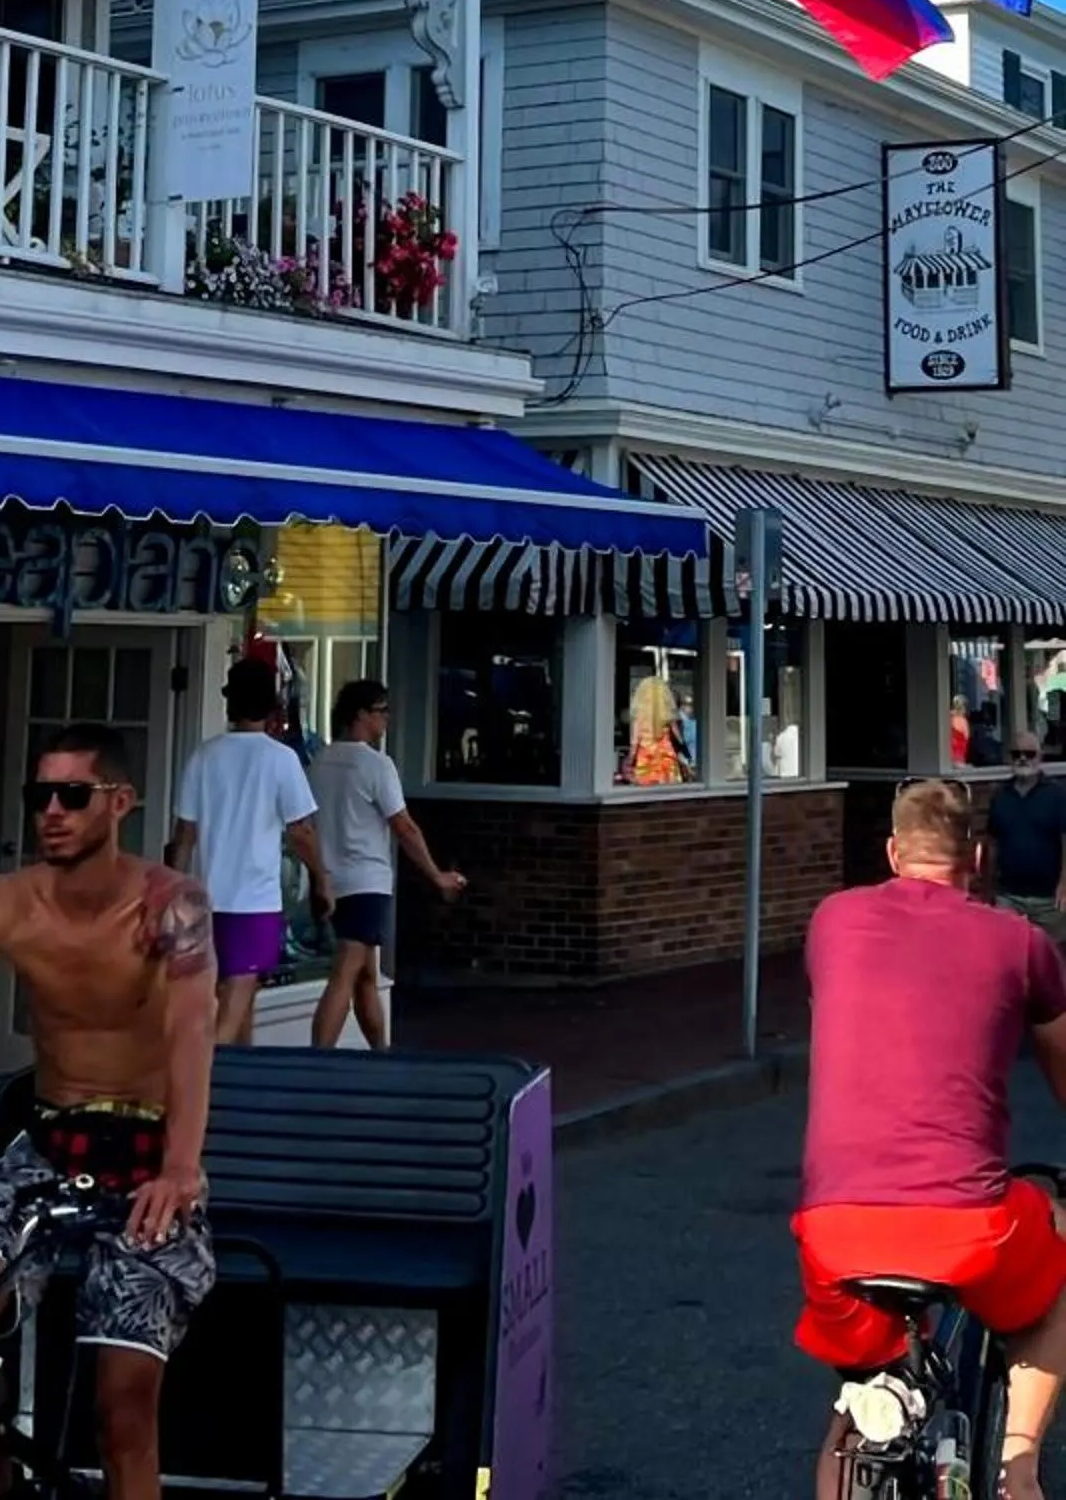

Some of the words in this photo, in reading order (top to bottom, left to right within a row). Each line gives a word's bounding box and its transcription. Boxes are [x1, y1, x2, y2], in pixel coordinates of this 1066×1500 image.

[926, 181, 955, 196] THE
[891, 200, 991, 234] MAYFLOWER
[894, 317, 931, 343] FOOD
[934, 332, 943, 344] &
[948, 313, 992, 343] DRINK
